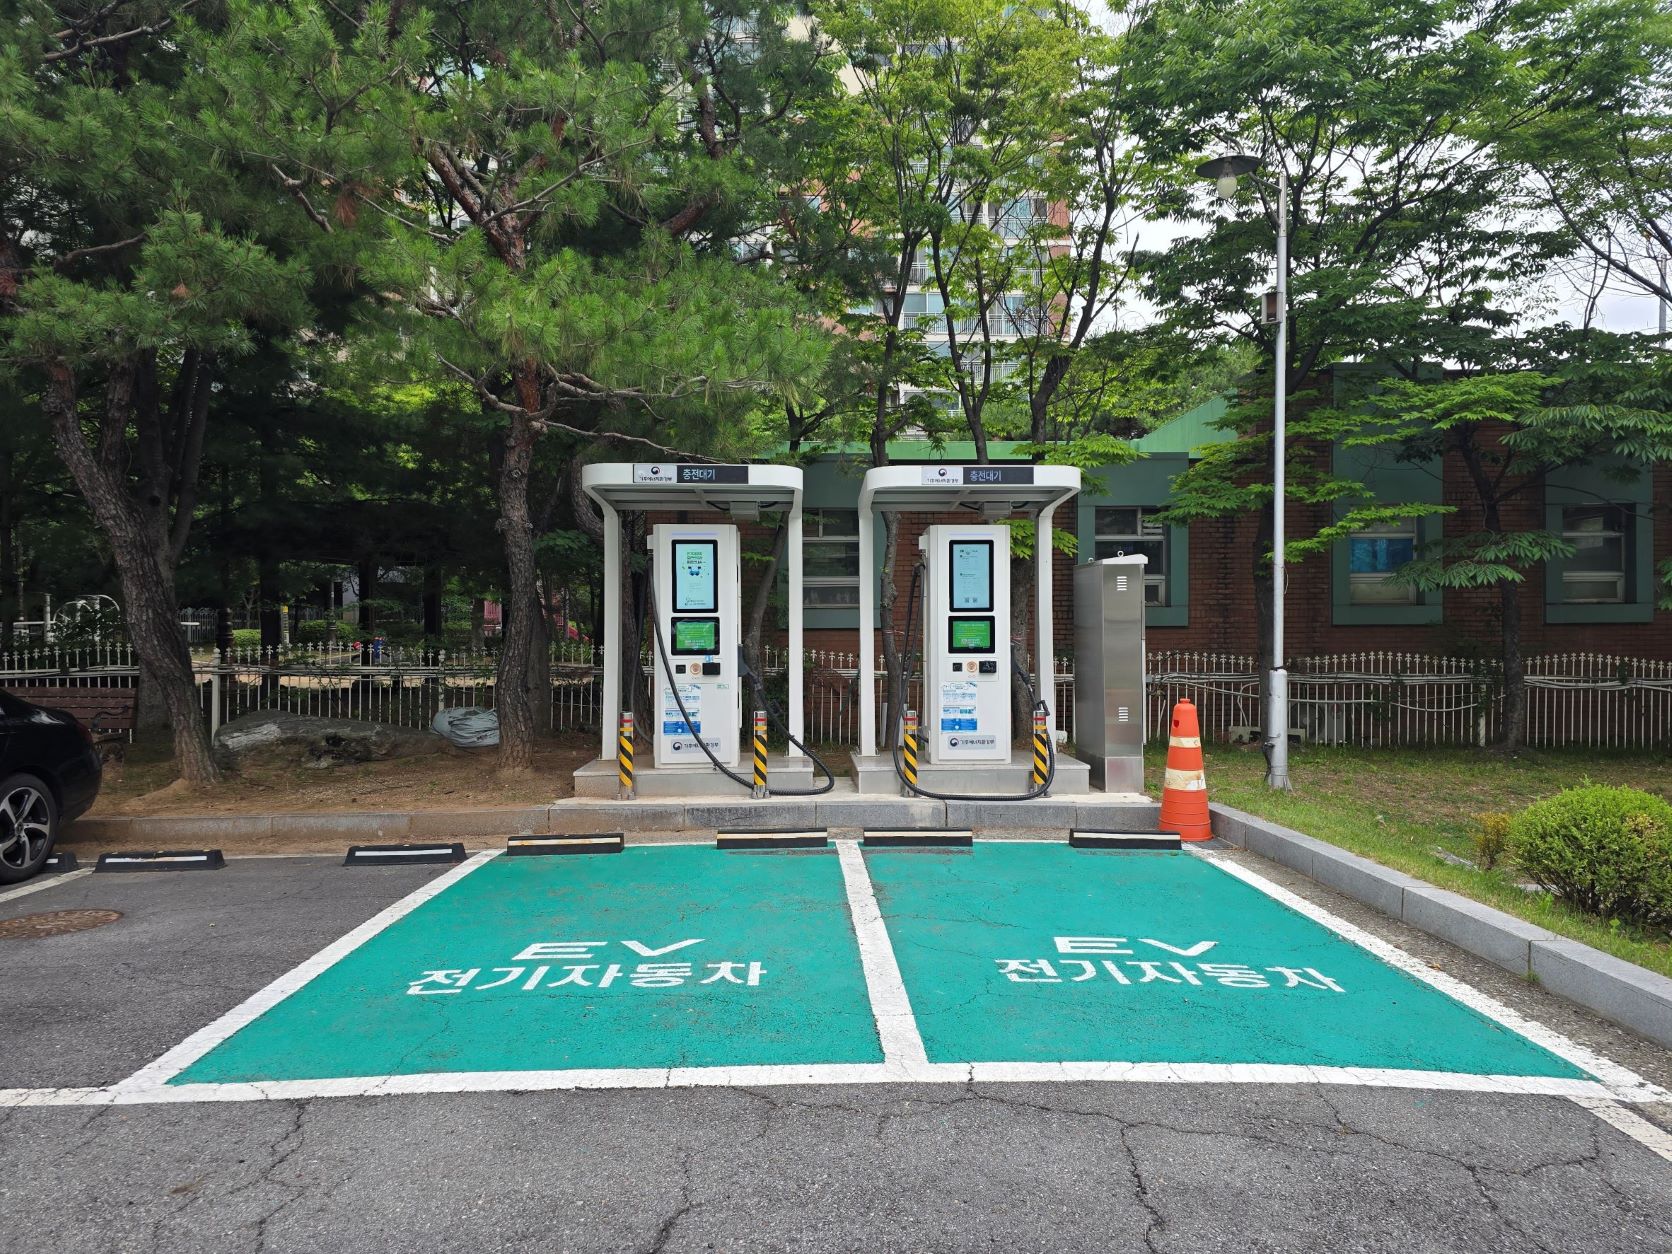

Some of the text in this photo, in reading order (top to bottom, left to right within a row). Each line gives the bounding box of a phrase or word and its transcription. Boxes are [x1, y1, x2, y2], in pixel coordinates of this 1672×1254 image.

[683, 469, 716, 480] 충전대기
[970, 470, 1002, 481] 충전대기
[511, 938, 705, 961] EV
[1053, 936, 1219, 957] EV
[406, 961, 767, 996] 전기자동차
[995, 959, 1346, 993] 전기자동차
